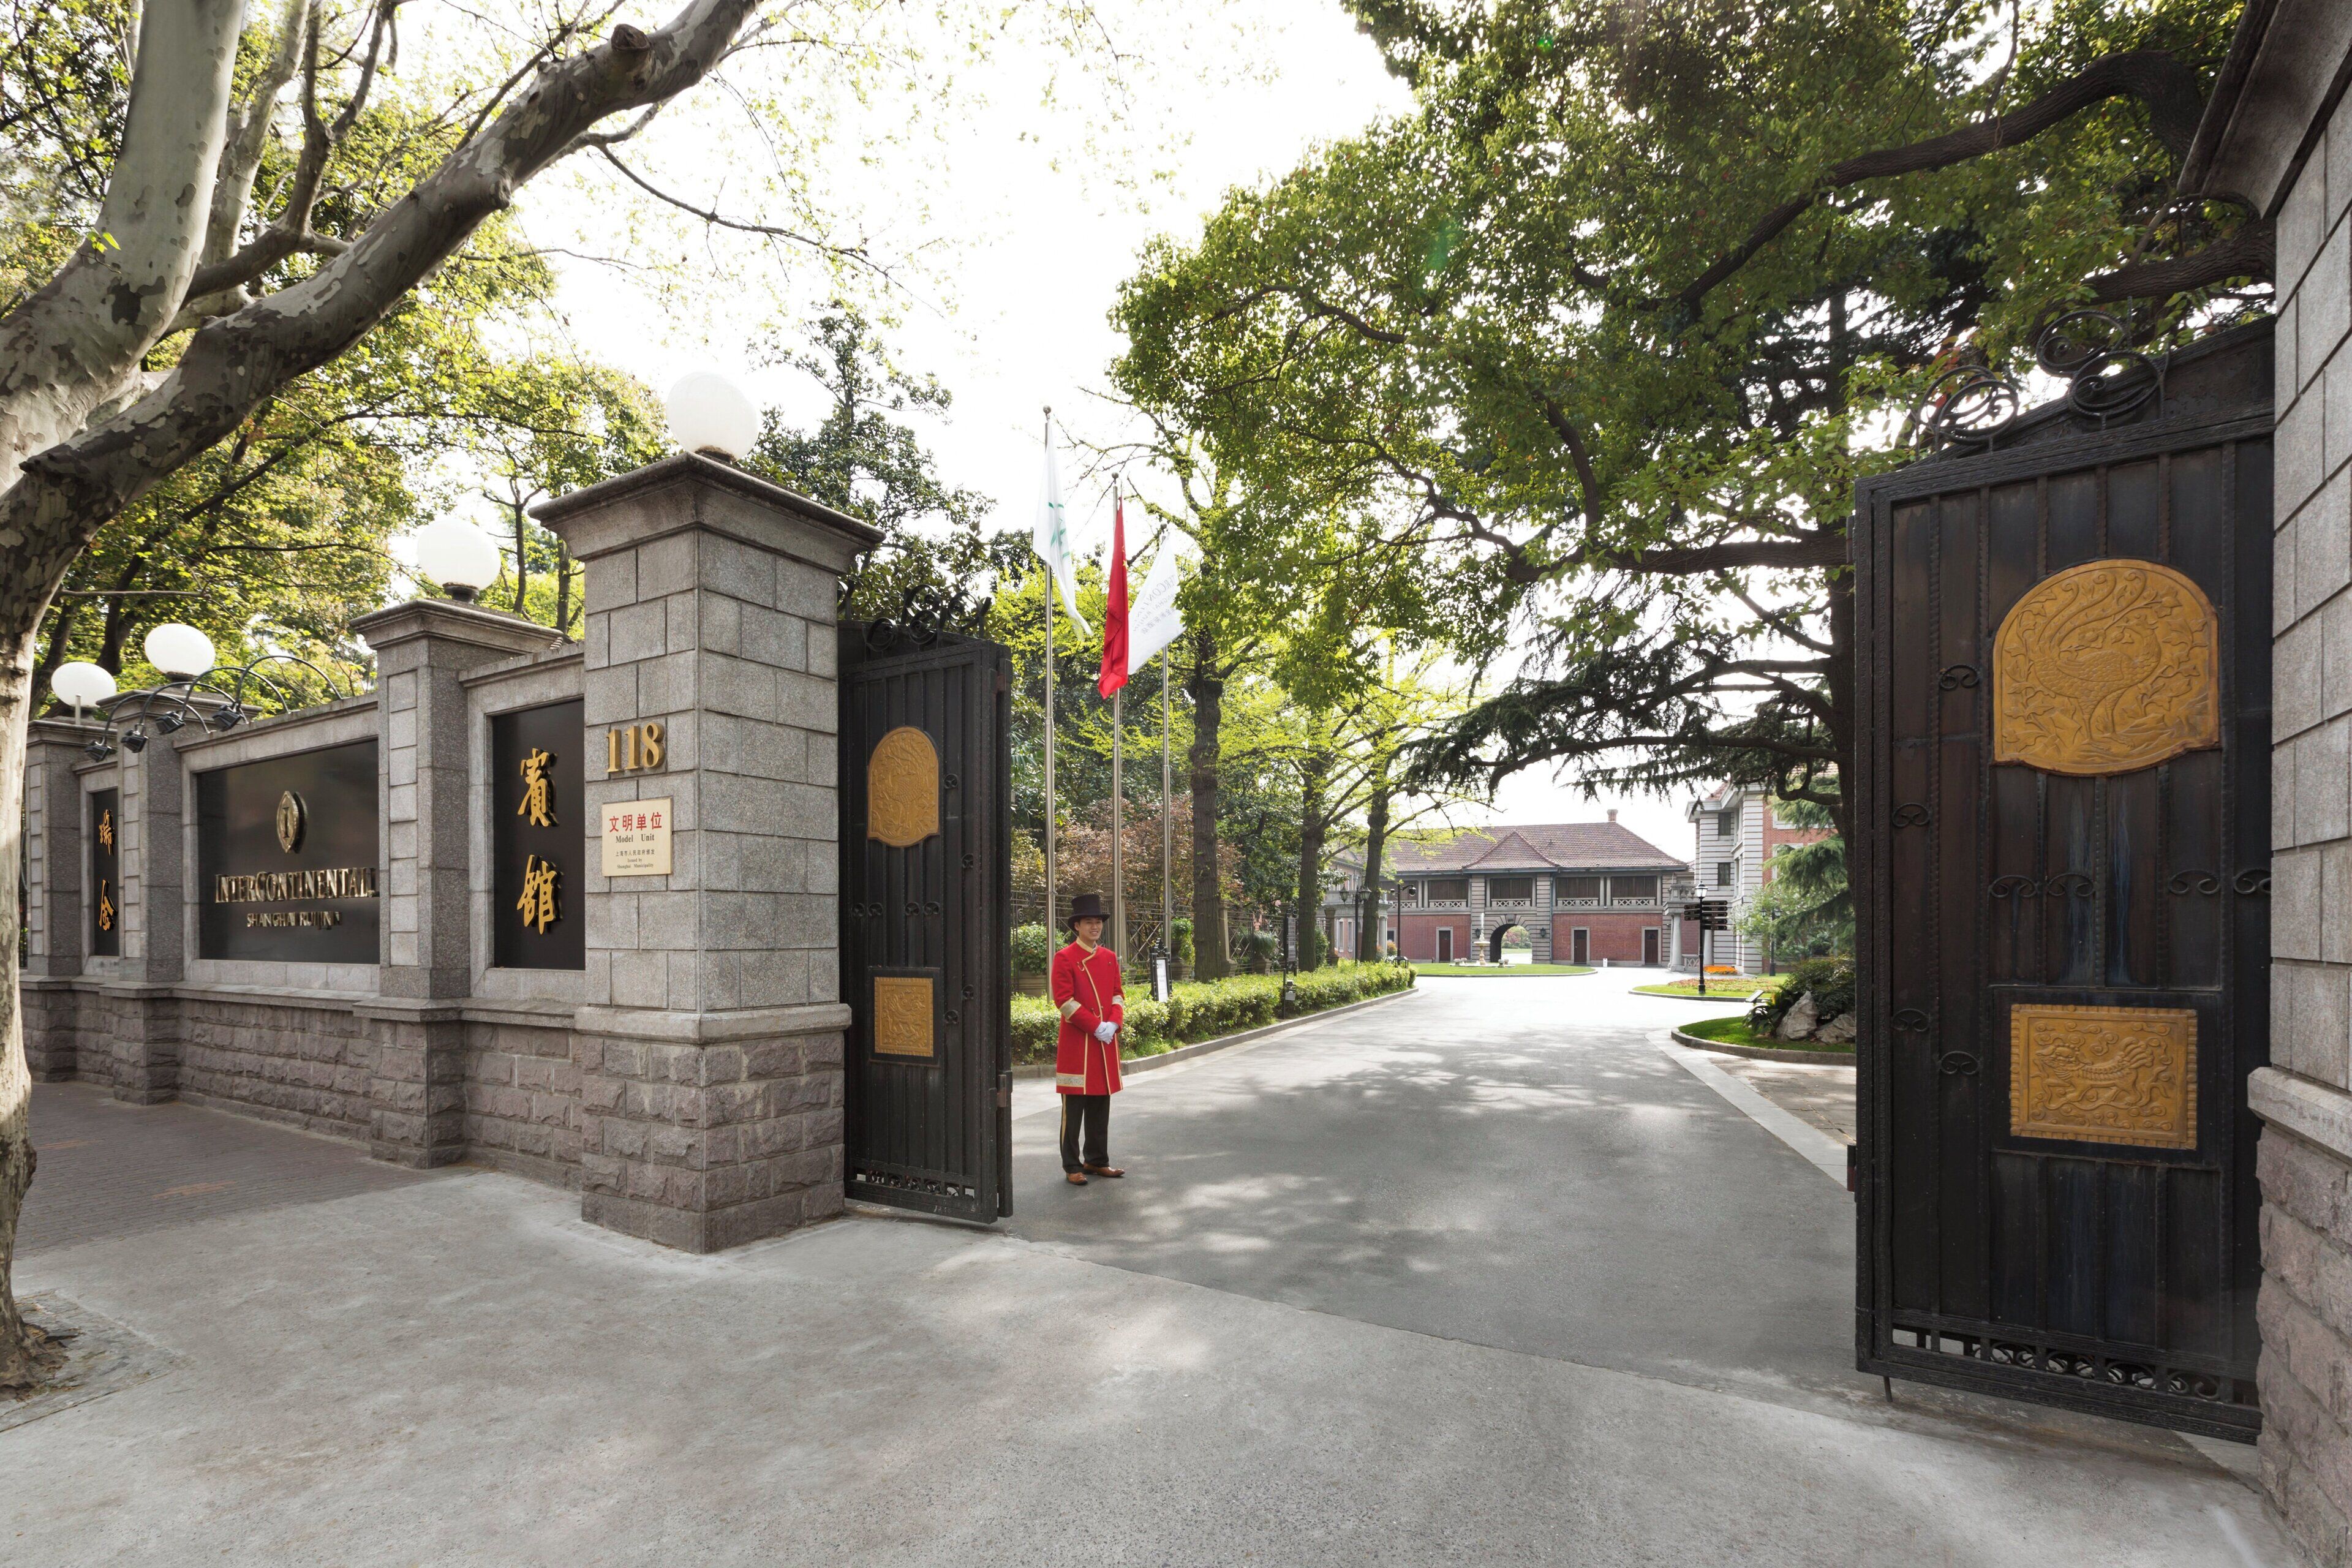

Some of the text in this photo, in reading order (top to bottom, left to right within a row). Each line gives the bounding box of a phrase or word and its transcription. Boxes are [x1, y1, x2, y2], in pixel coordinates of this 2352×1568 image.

[605, 722, 664, 773] 118
[609, 812, 662, 832] 文明单位
[616, 833, 654, 843] Model Unit
[247, 912, 295, 927] SHANGHAI
